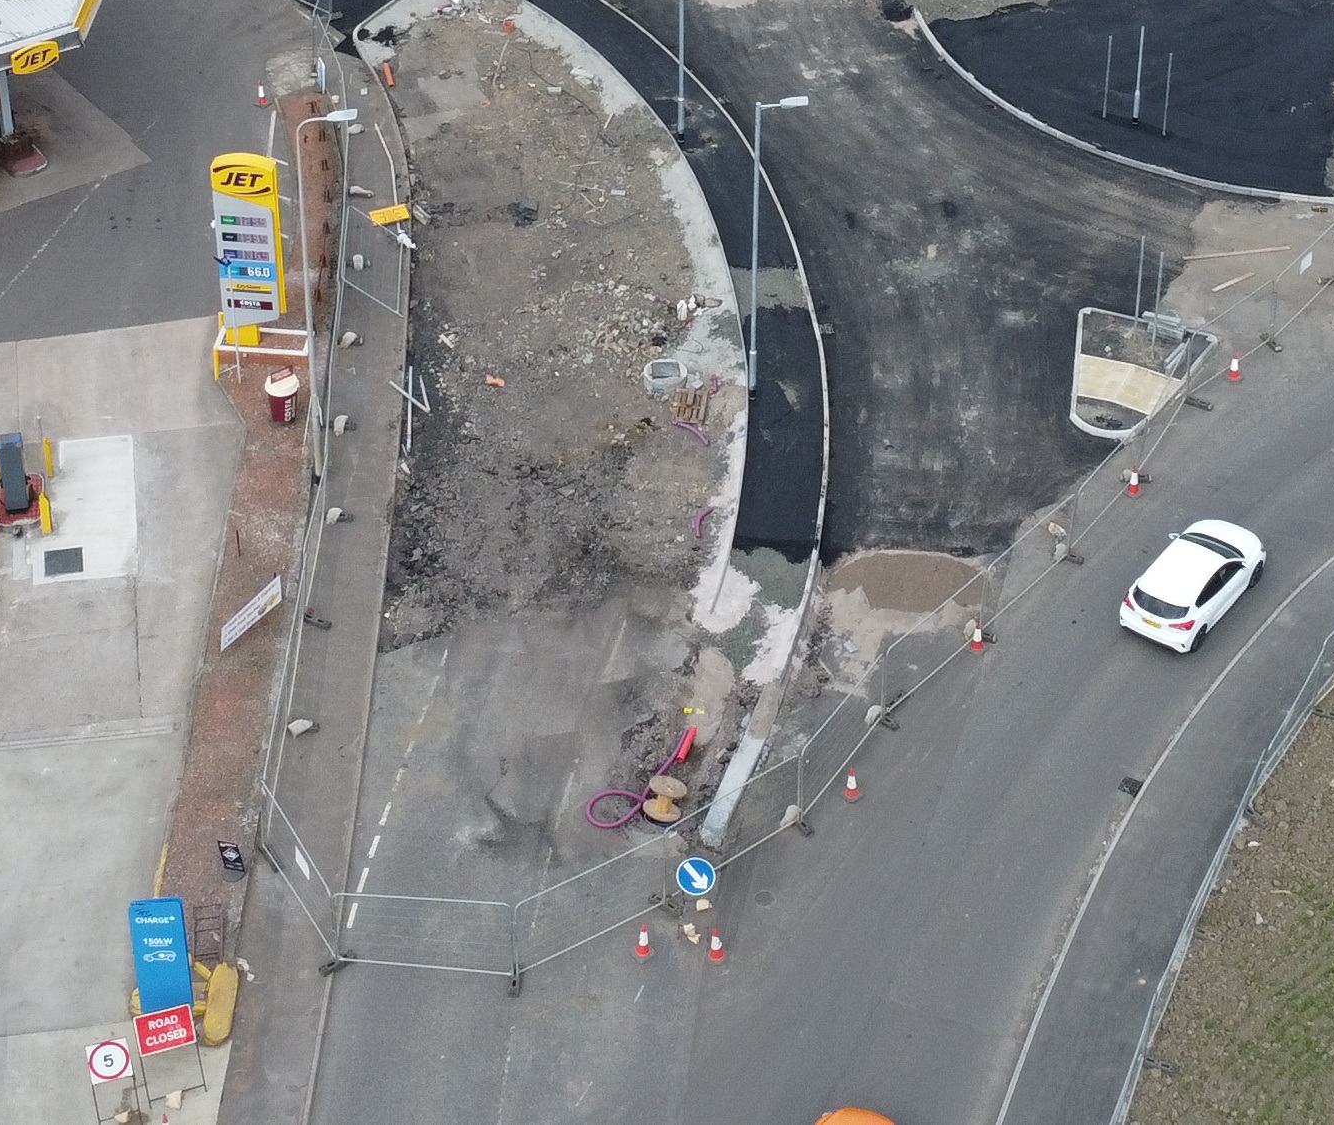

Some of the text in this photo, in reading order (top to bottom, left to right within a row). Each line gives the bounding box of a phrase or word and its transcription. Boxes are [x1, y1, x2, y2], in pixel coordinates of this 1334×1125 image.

[20, 48, 52, 69] JET
[220, 171, 264, 187] JET
[247, 266, 271, 277] 66.0
[148, 1015, 179, 1030] ROAD
[145, 1028, 187, 1047] CLOSED
[103, 1054, 114, 1068] 5
